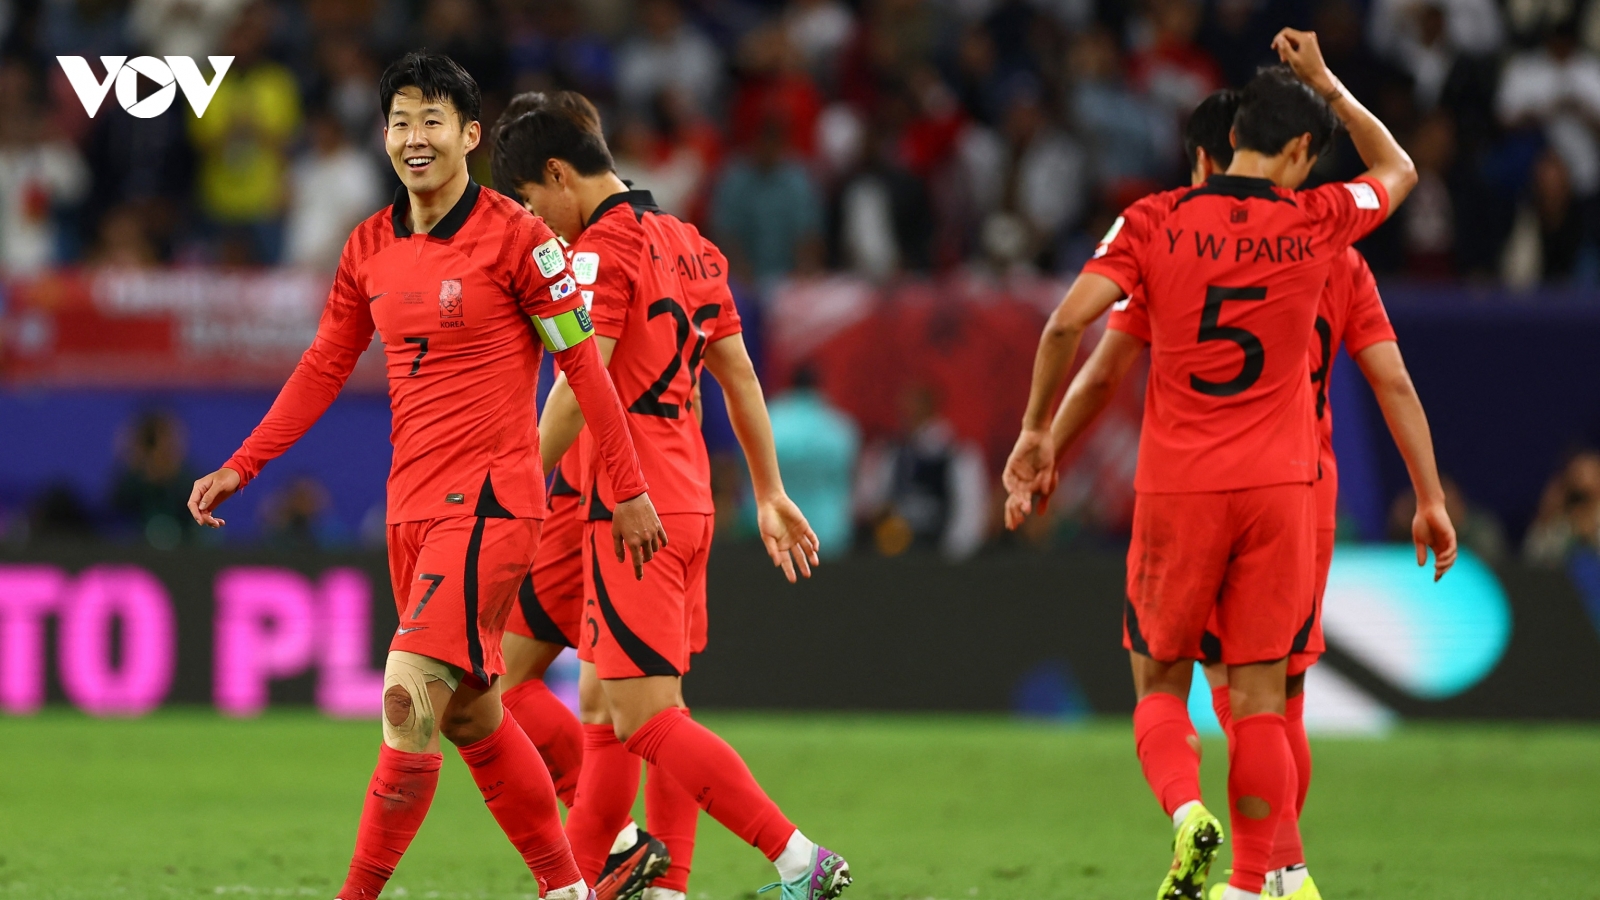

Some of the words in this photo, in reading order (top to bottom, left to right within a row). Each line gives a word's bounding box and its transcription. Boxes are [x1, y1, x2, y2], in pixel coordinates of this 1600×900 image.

[538, 247, 551, 258] AFC
[540, 249, 560, 266] LIVE
[1166, 229, 1183, 254] Y
[1195, 231, 1226, 260] W
[1235, 236, 1314, 263] PARK
[440, 320, 465, 328] KOREA
[1189, 284, 1267, 397] 5
[404, 337, 429, 376] 7
[411, 573, 446, 620] 7
